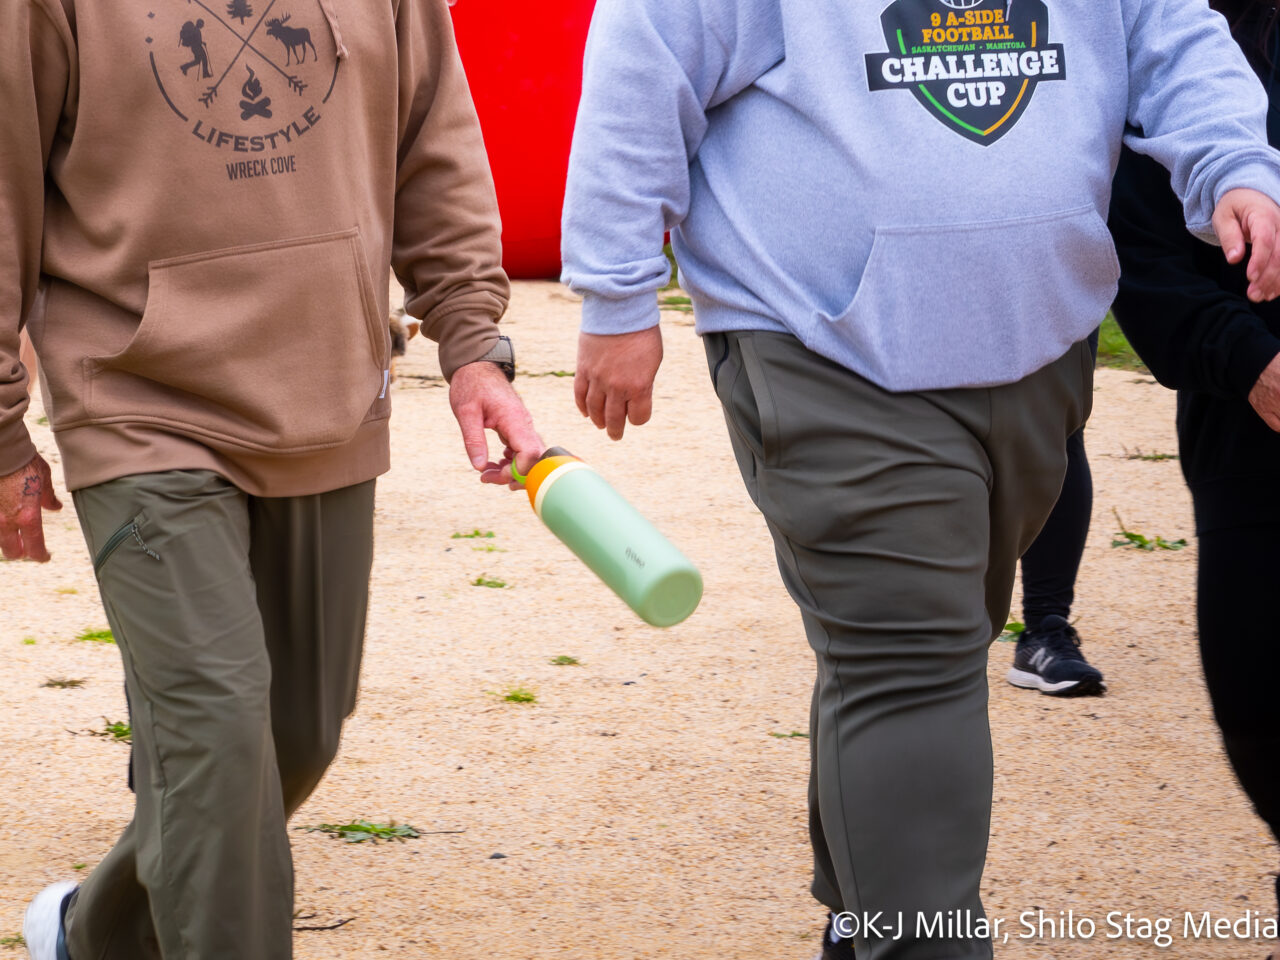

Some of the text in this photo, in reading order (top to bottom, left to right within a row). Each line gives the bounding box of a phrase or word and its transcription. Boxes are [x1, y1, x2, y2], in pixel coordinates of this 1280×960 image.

[930, 9, 1005, 27] 9 A-SIDE
[922, 25, 1015, 43] FOOTBALL
[911, 43, 976, 54] SASKATCHEWAN
[986, 41, 1026, 50] MANITOBA
[881, 49, 1059, 83] CHALLENGE
[946, 81, 1006, 108] CUP
[191, 105, 321, 152] LIFESTYLE
[226, 155, 297, 181] WRECK COVE
